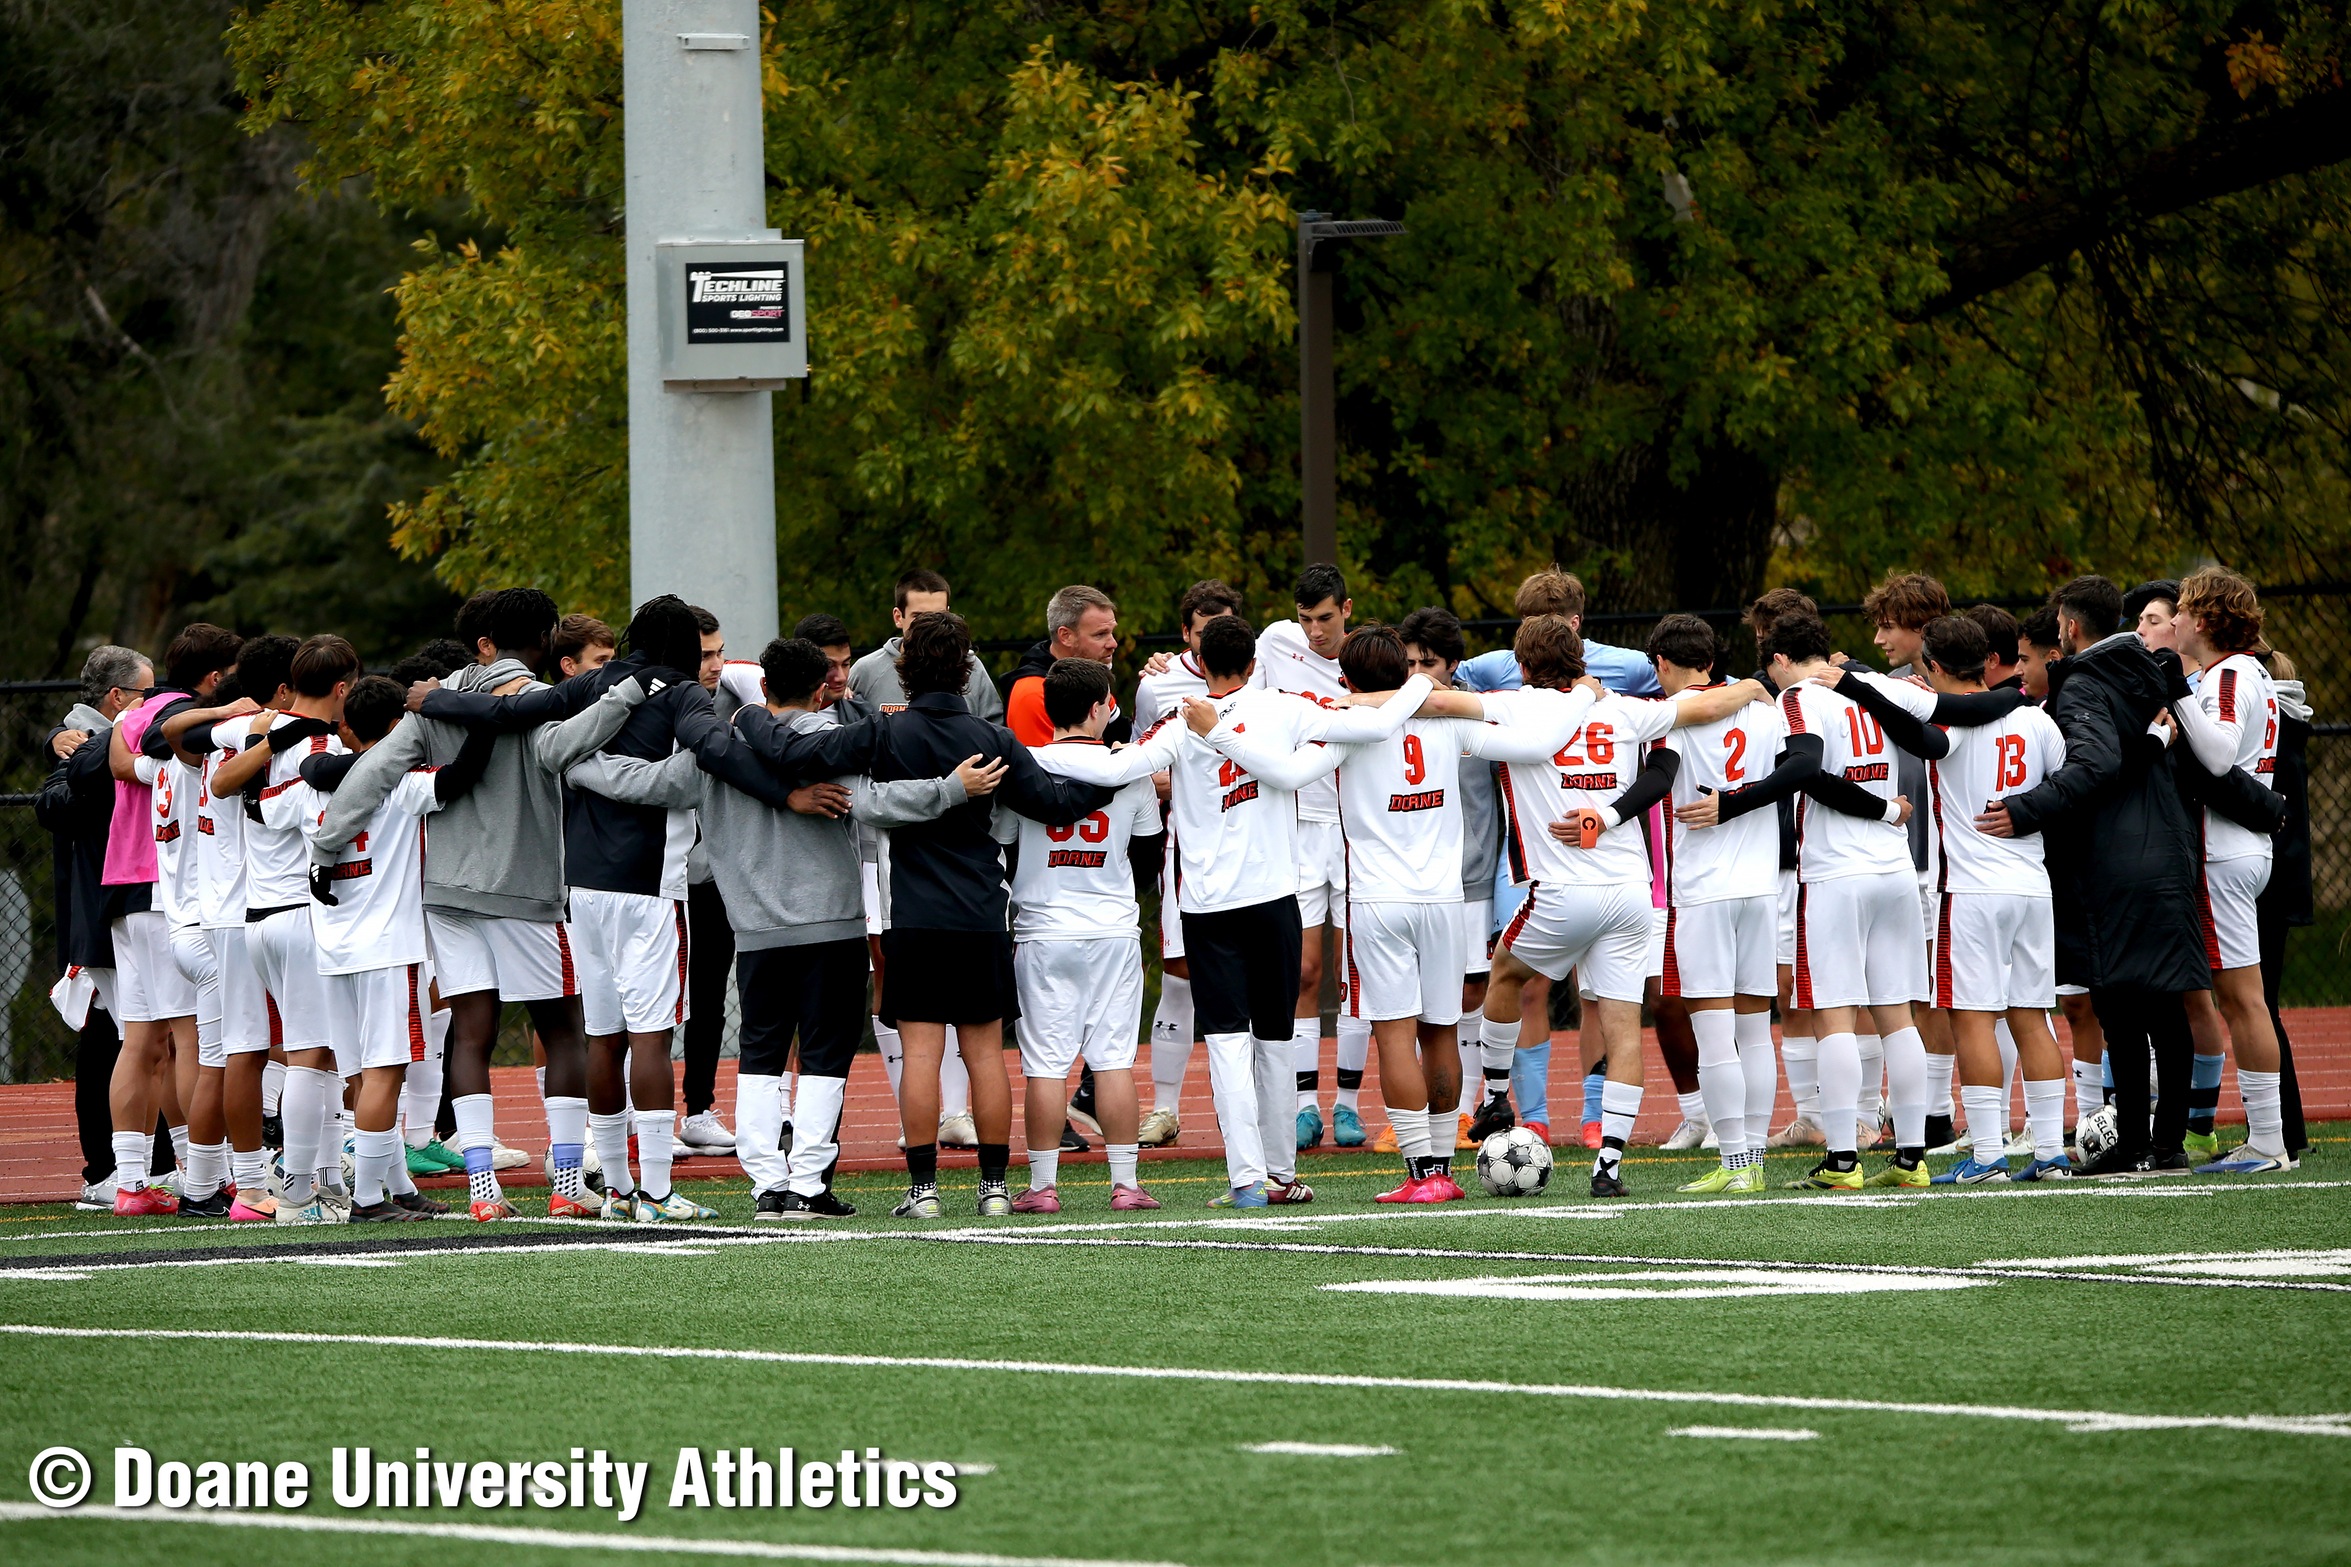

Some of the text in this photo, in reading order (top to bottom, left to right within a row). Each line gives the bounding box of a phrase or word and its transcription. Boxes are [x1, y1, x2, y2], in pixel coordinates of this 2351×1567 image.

[690, 271, 786, 302] TECHLINE
[702, 293, 782, 302] SPORTS LIGHTING
[730, 309, 784, 319] GEOSPORT
[1553, 722, 1614, 766] 26
[1845, 706, 1884, 757] 10
[1403, 734, 1425, 785] 9
[1723, 728, 1746, 782] 2
[1995, 734, 2026, 791] 13
[1561, 773, 1617, 790] DOANE
[1843, 763, 1888, 782] DOANE
[1388, 789, 1444, 812] DOANE
[1048, 850, 1107, 868] DOANE
[2094, 1115, 2117, 1146] SELEC
